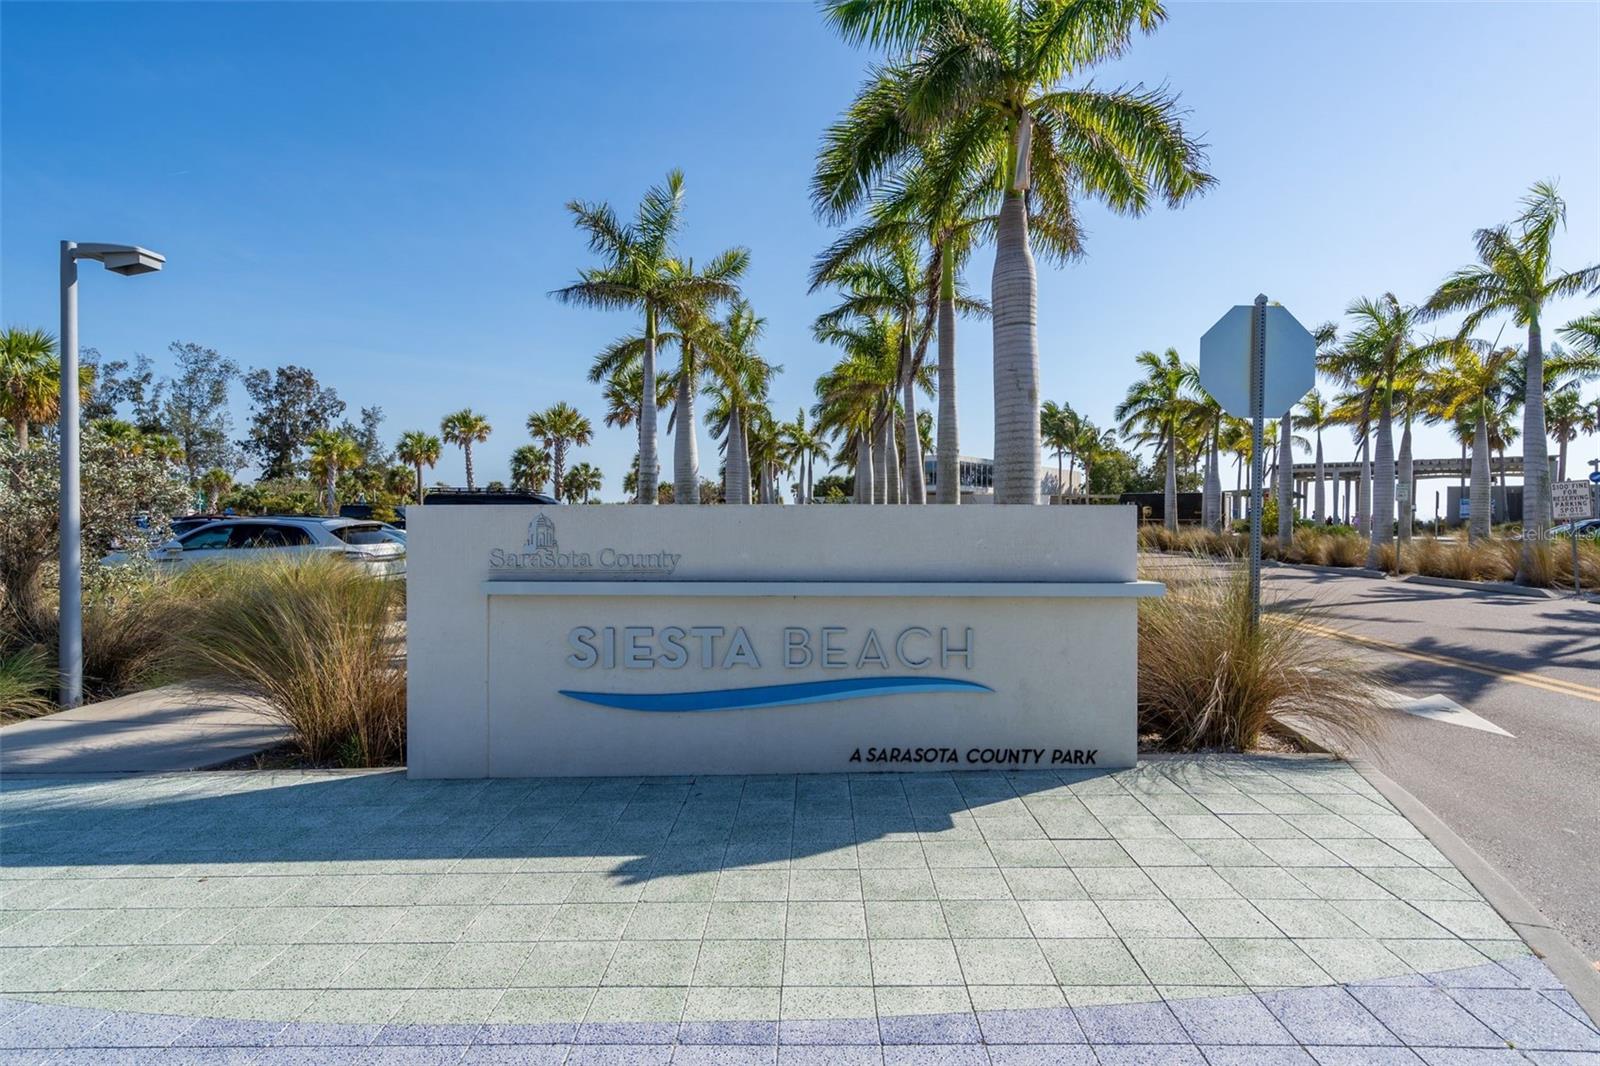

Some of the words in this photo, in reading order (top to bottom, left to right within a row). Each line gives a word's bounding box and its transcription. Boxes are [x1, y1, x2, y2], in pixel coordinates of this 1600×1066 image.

[599, 548, 681, 575] County
[567, 626, 761, 670] SIESTA
[783, 626, 974, 670] BEACH
[849, 747, 862, 763] A
[865, 748, 958, 764] SARASOTA
[966, 748, 1046, 764] COUNTY
[1051, 749, 1098, 765] PARK
